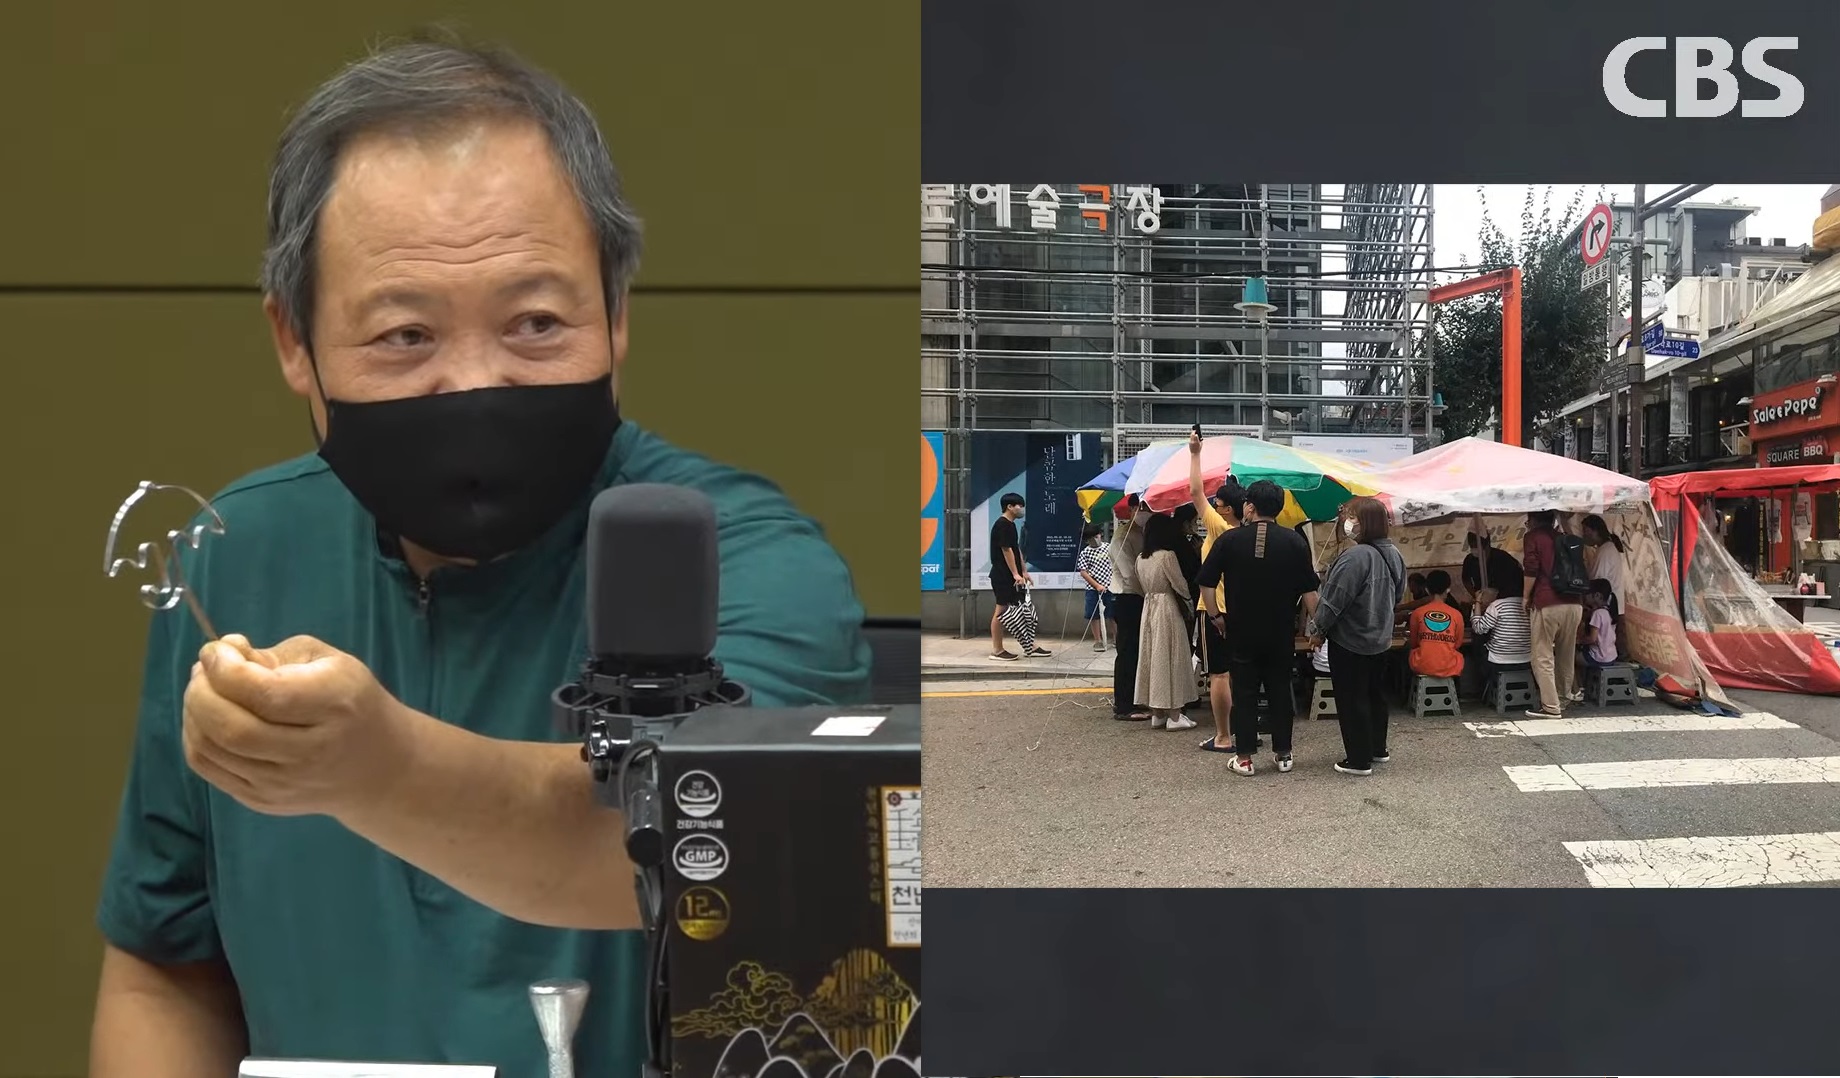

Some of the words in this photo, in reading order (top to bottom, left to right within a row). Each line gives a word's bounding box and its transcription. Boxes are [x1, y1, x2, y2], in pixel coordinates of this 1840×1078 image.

[1767, 449, 1799, 463] SQUARE
[1804, 445, 1823, 457] BBQ
[685, 851, 716, 862] GMP
